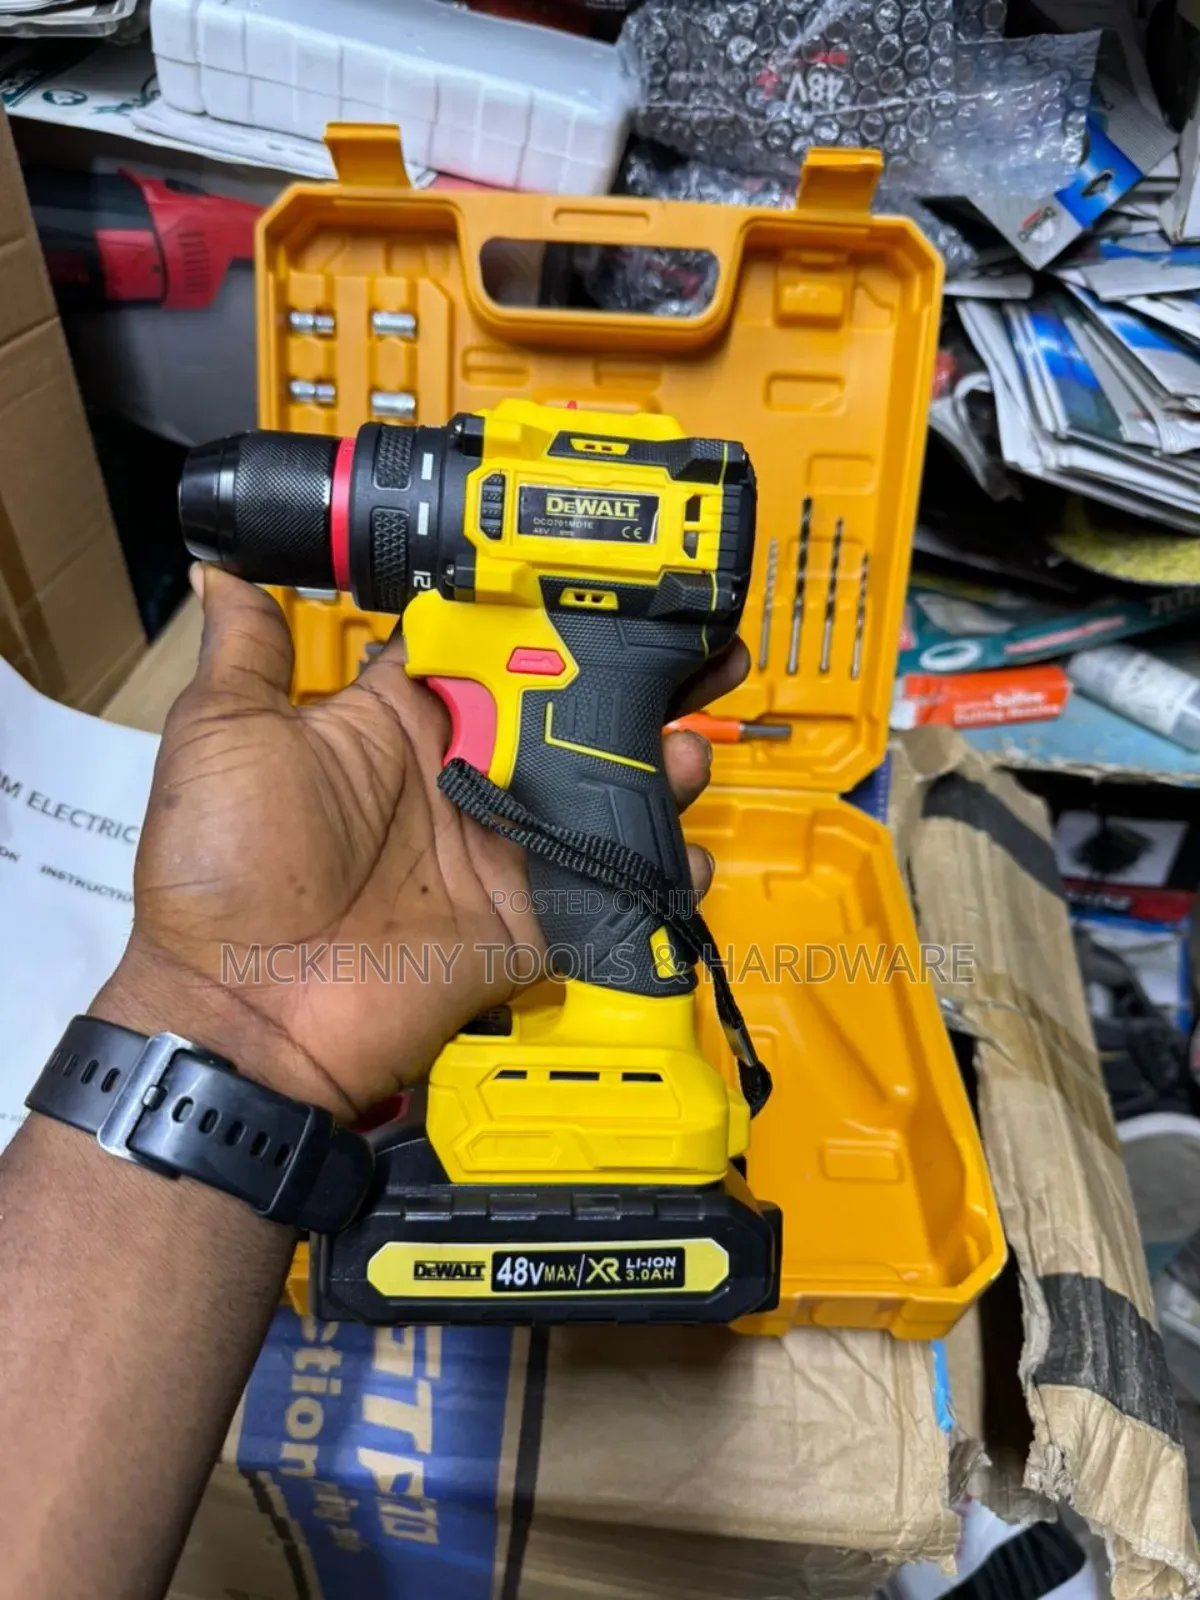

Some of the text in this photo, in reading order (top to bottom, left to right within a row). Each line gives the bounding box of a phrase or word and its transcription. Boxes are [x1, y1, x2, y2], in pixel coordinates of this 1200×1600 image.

[546, 496, 641, 518] DEWALT
[27, 790, 140, 844] ELECTRIC
[413, 1261, 486, 1280] DEWALT
[626, 1256, 677, 1268] LI-ION
[626, 1268, 675, 1281] 3.0AH
